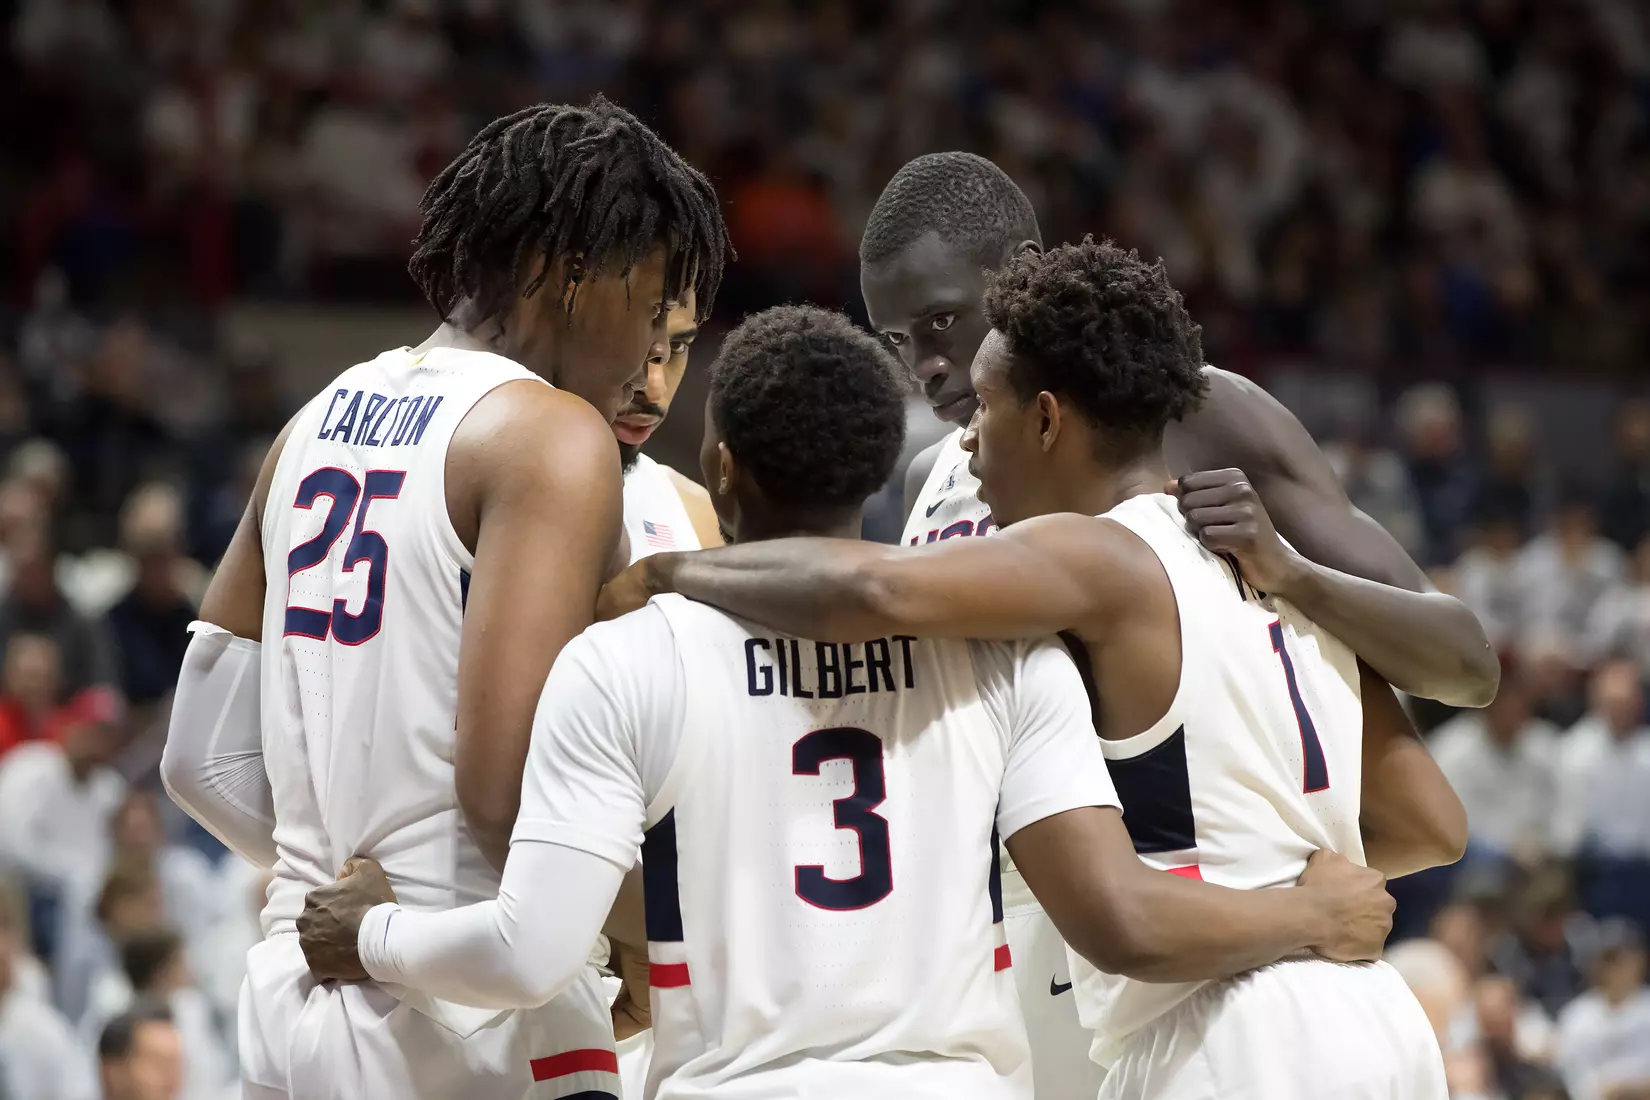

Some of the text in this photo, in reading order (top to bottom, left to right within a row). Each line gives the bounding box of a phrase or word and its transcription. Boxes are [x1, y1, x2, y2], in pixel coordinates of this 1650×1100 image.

[317, 388, 444, 448] CARLTON
[283, 466, 407, 646] 25
[744, 635, 918, 699] GILBERT
[1268, 618, 1330, 794] 1
[792, 726, 894, 912] 3
